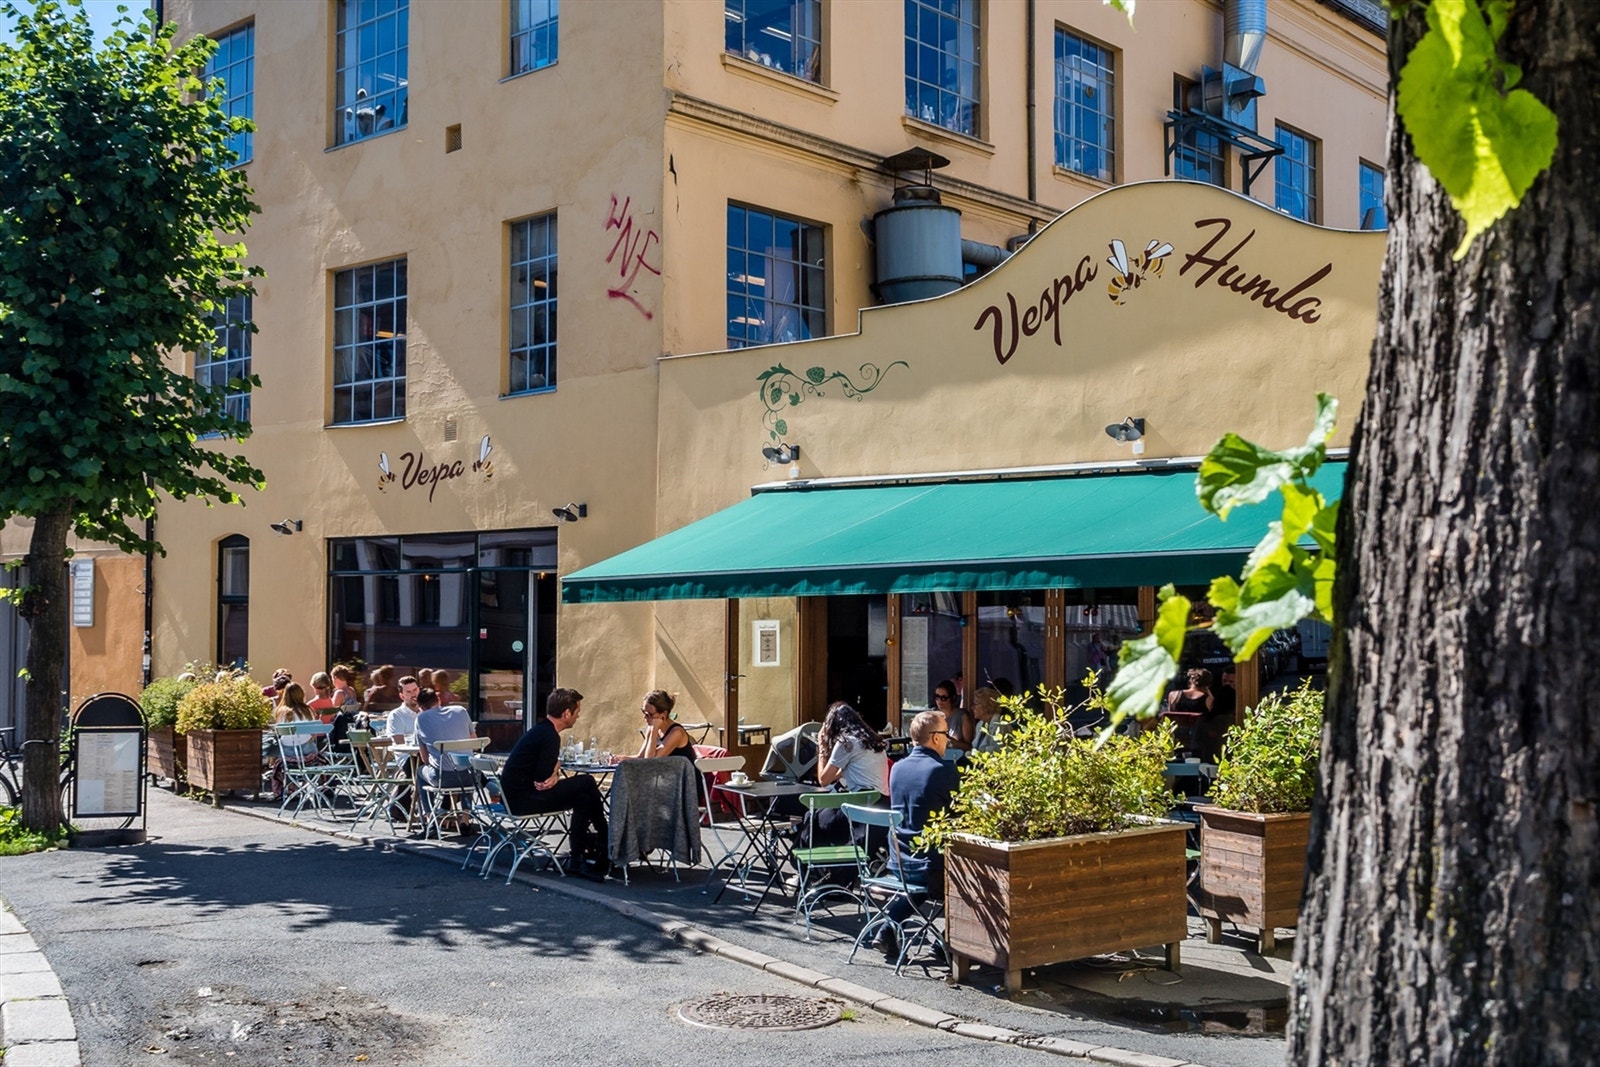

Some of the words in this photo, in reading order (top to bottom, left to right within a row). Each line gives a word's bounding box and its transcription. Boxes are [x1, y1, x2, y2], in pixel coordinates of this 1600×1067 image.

[973, 254, 1099, 366] Vespa
[1179, 217, 1333, 325] Humla
[399, 451, 466, 503] Vespa
